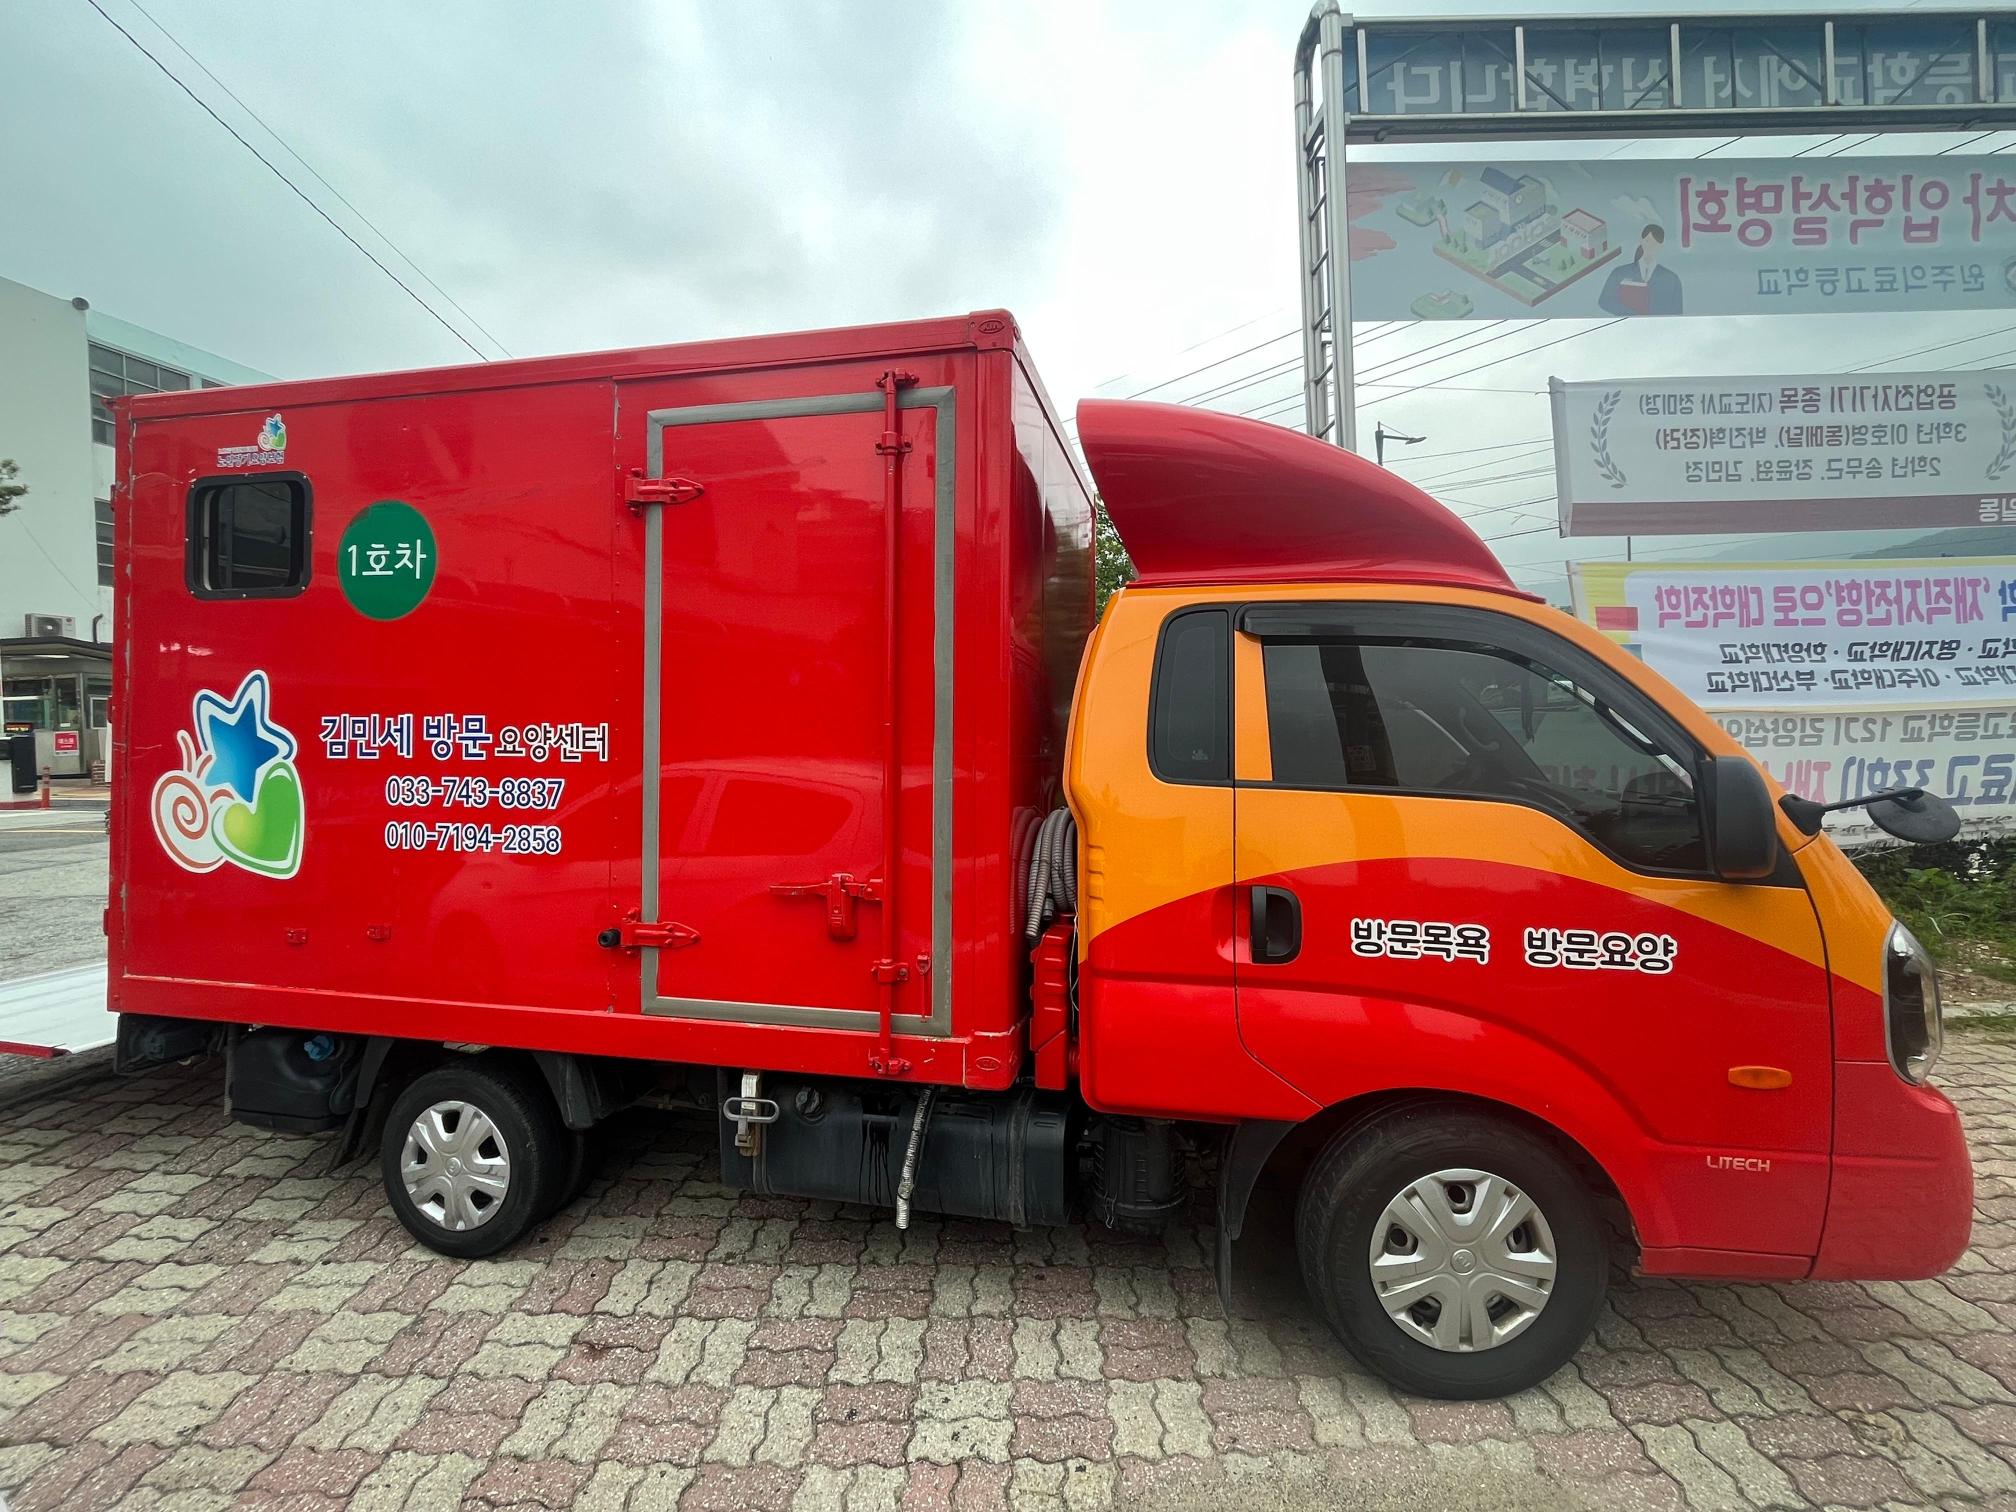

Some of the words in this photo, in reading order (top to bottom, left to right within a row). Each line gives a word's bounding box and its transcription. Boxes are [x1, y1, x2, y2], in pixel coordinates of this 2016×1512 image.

[347, 539, 427, 580] 1호차
[319, 713, 413, 759] 김민세
[423, 715, 492, 761] 방문
[495, 723, 609, 762] 요양센터
[385, 776, 564, 809] 033-743-8837
[385, 822, 561, 854] 010-7194-2858
[1350, 917, 1490, 964] 방문목욕
[1523, 927, 1678, 974] 방문요양
[1706, 1155, 1771, 1173] LITECH
